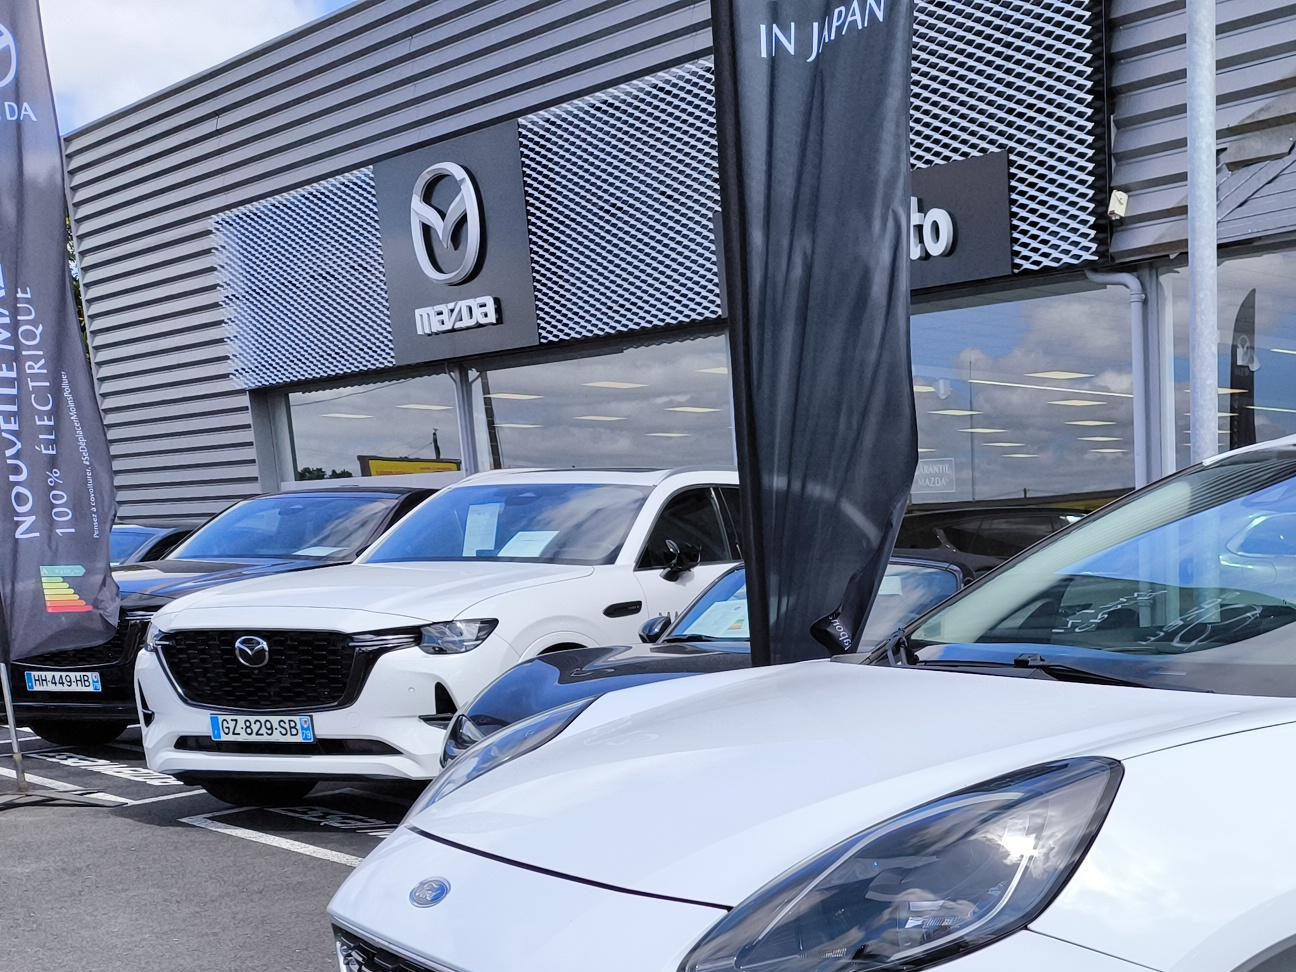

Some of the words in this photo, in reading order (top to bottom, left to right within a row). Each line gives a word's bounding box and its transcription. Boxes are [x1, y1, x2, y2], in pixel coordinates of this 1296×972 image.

[760, 22, 795, 58] IN
[807, 0, 885, 62] JAPAN
[910, 196, 954, 260] to
[415, 296, 497, 335] mazda
[16, 286, 57, 455] ÉLECTRIQUE
[0, 361, 40, 539] NOUVELLE
[46, 468, 76, 537] 100%
[33, 674, 91, 688] HH-449-HB
[221, 719, 299, 737] GZ-829-SB
